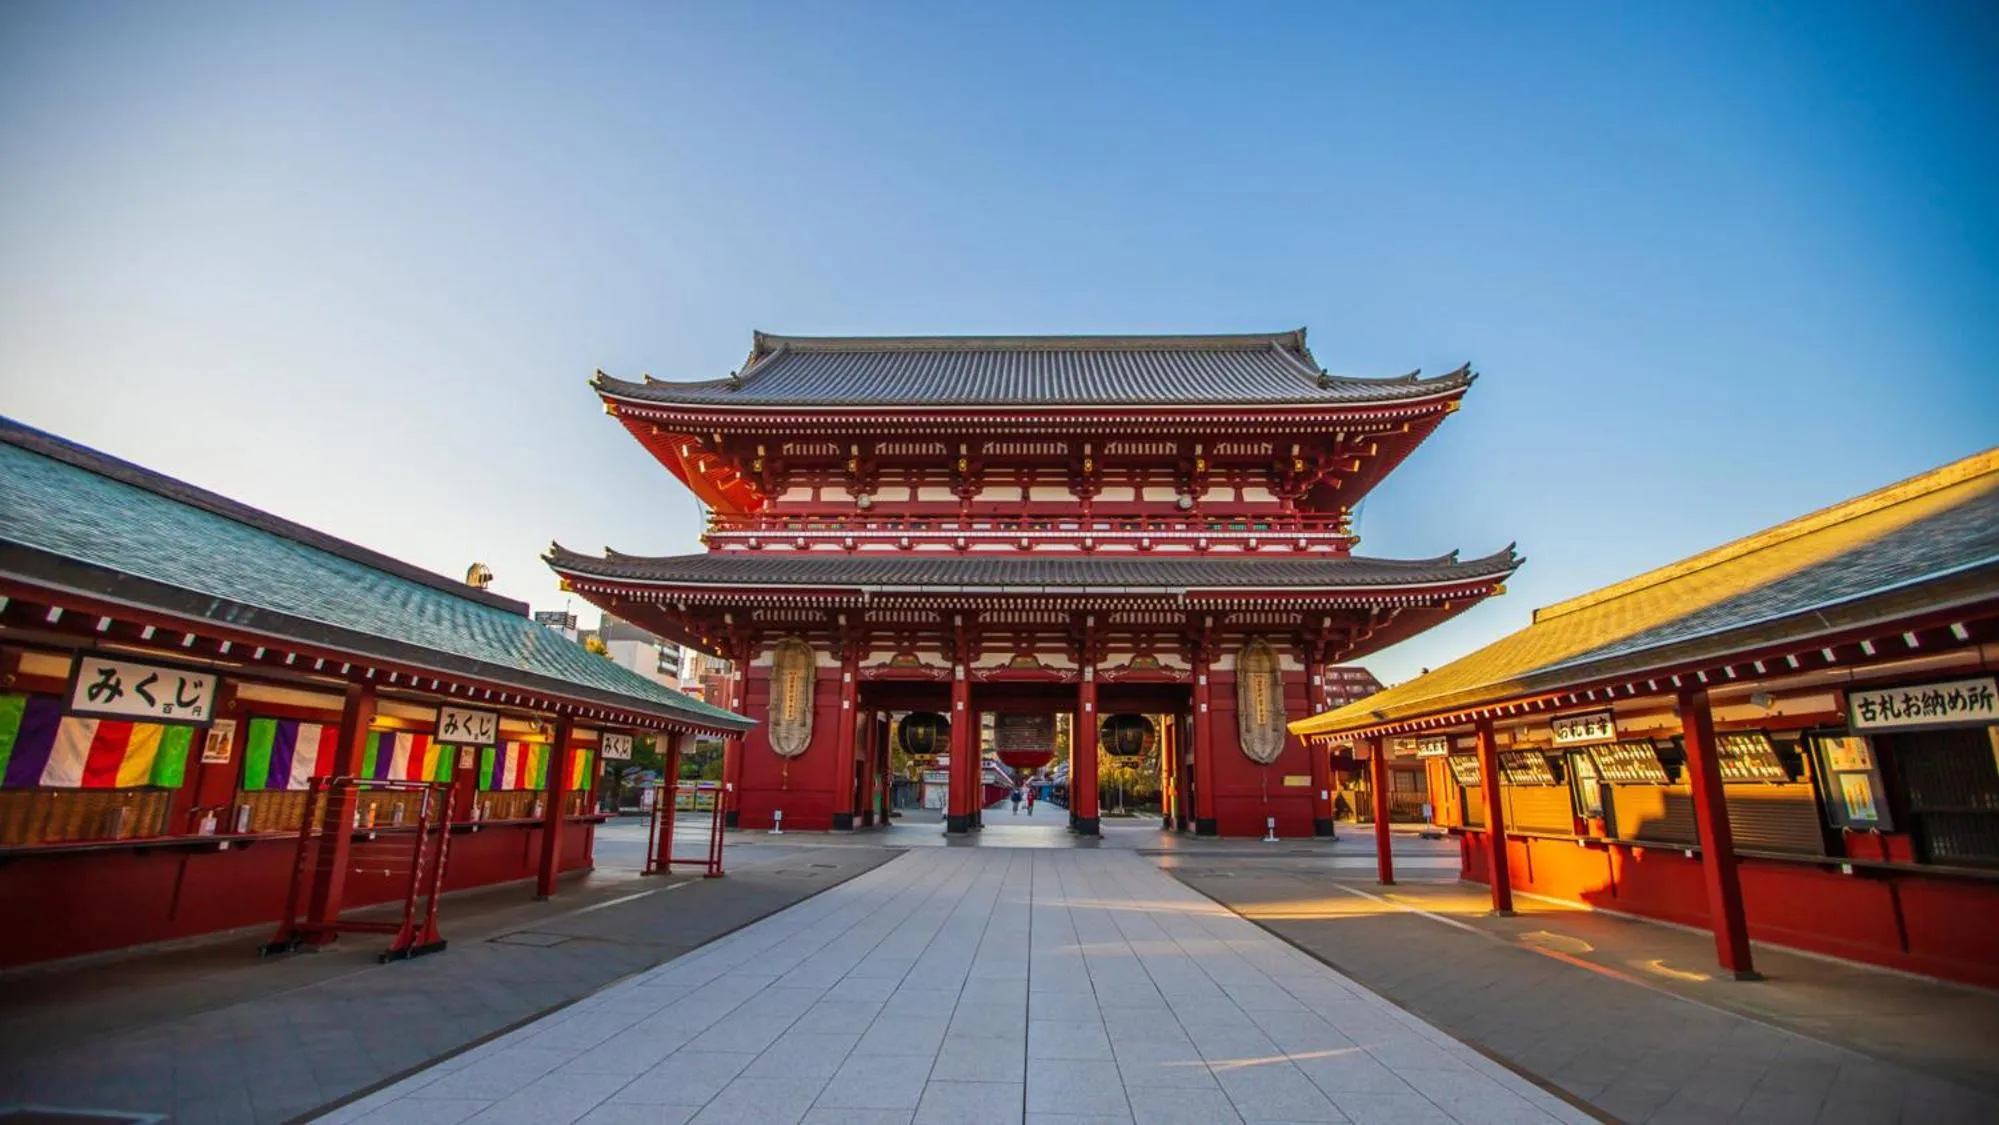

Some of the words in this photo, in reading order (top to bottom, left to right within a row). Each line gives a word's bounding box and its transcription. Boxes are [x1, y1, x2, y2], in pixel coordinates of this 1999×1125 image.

[88, 668, 203, 708] みくじ
[1858, 686, 1994, 722] 古札お納め所
[444, 713, 491, 736] みくじ
